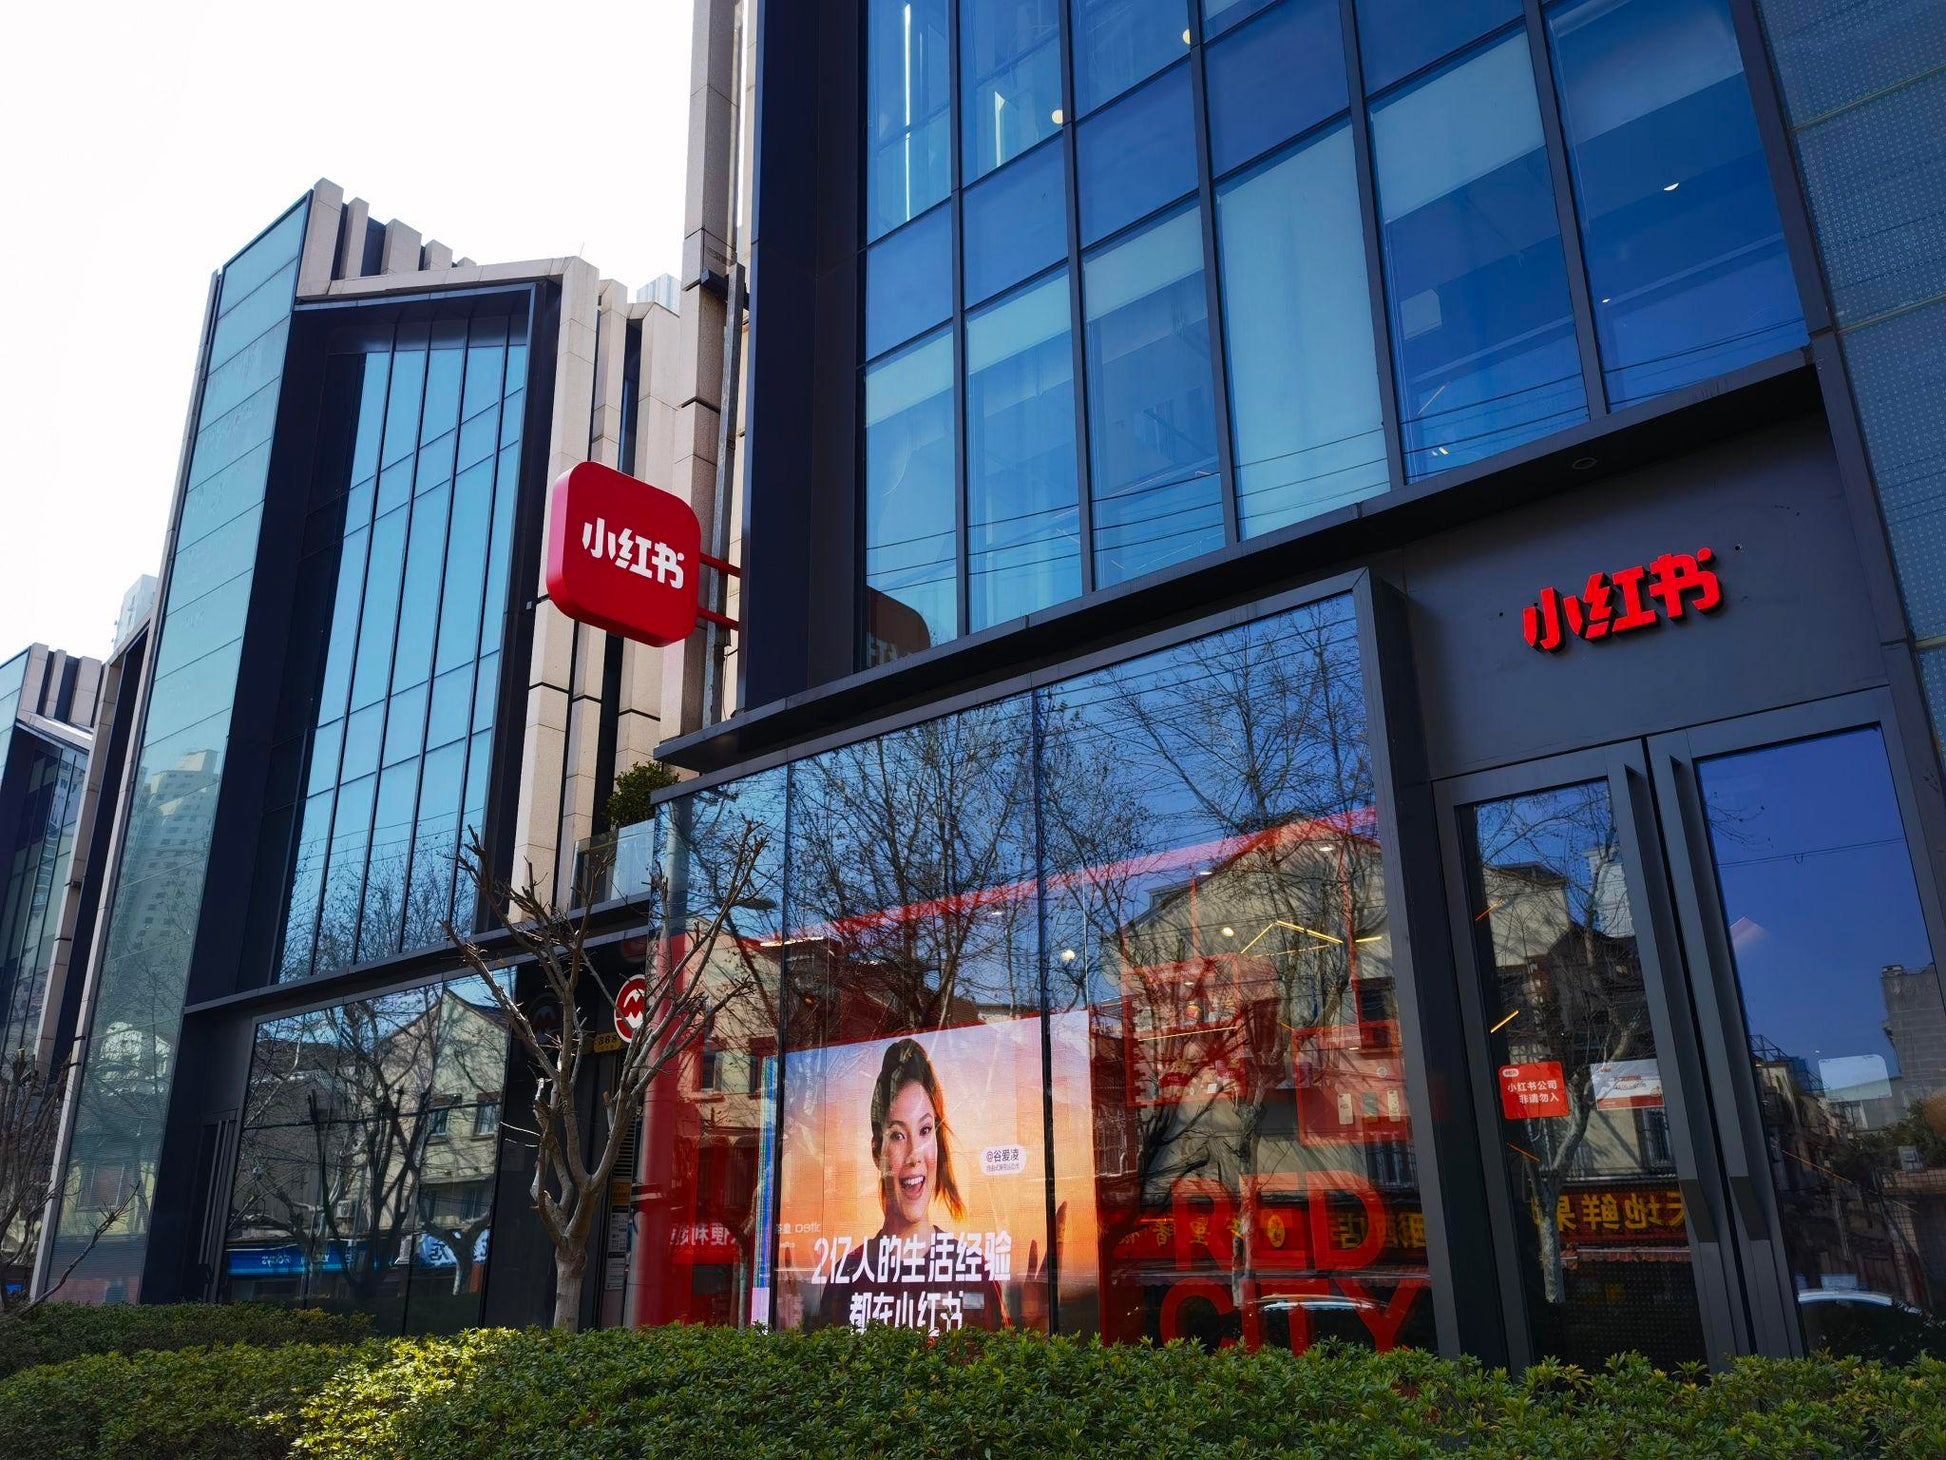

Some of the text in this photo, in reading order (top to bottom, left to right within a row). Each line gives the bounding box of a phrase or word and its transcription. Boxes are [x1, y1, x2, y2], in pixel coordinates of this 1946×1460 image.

[582, 517, 685, 590] 小红书
[1522, 547, 1722, 651] 小红书
[1507, 1080, 1558, 1092] 小红书公司
[1519, 1092, 1560, 1105] 非请勿入
[985, 1148, 1020, 1163] @谷爱凌
[1171, 1170, 1387, 1272] RED
[811, 1230, 1012, 1284] 2亿人的生活经验
[848, 1290, 965, 1337] 都在小红书
[1160, 1276, 1426, 1358] CITY
